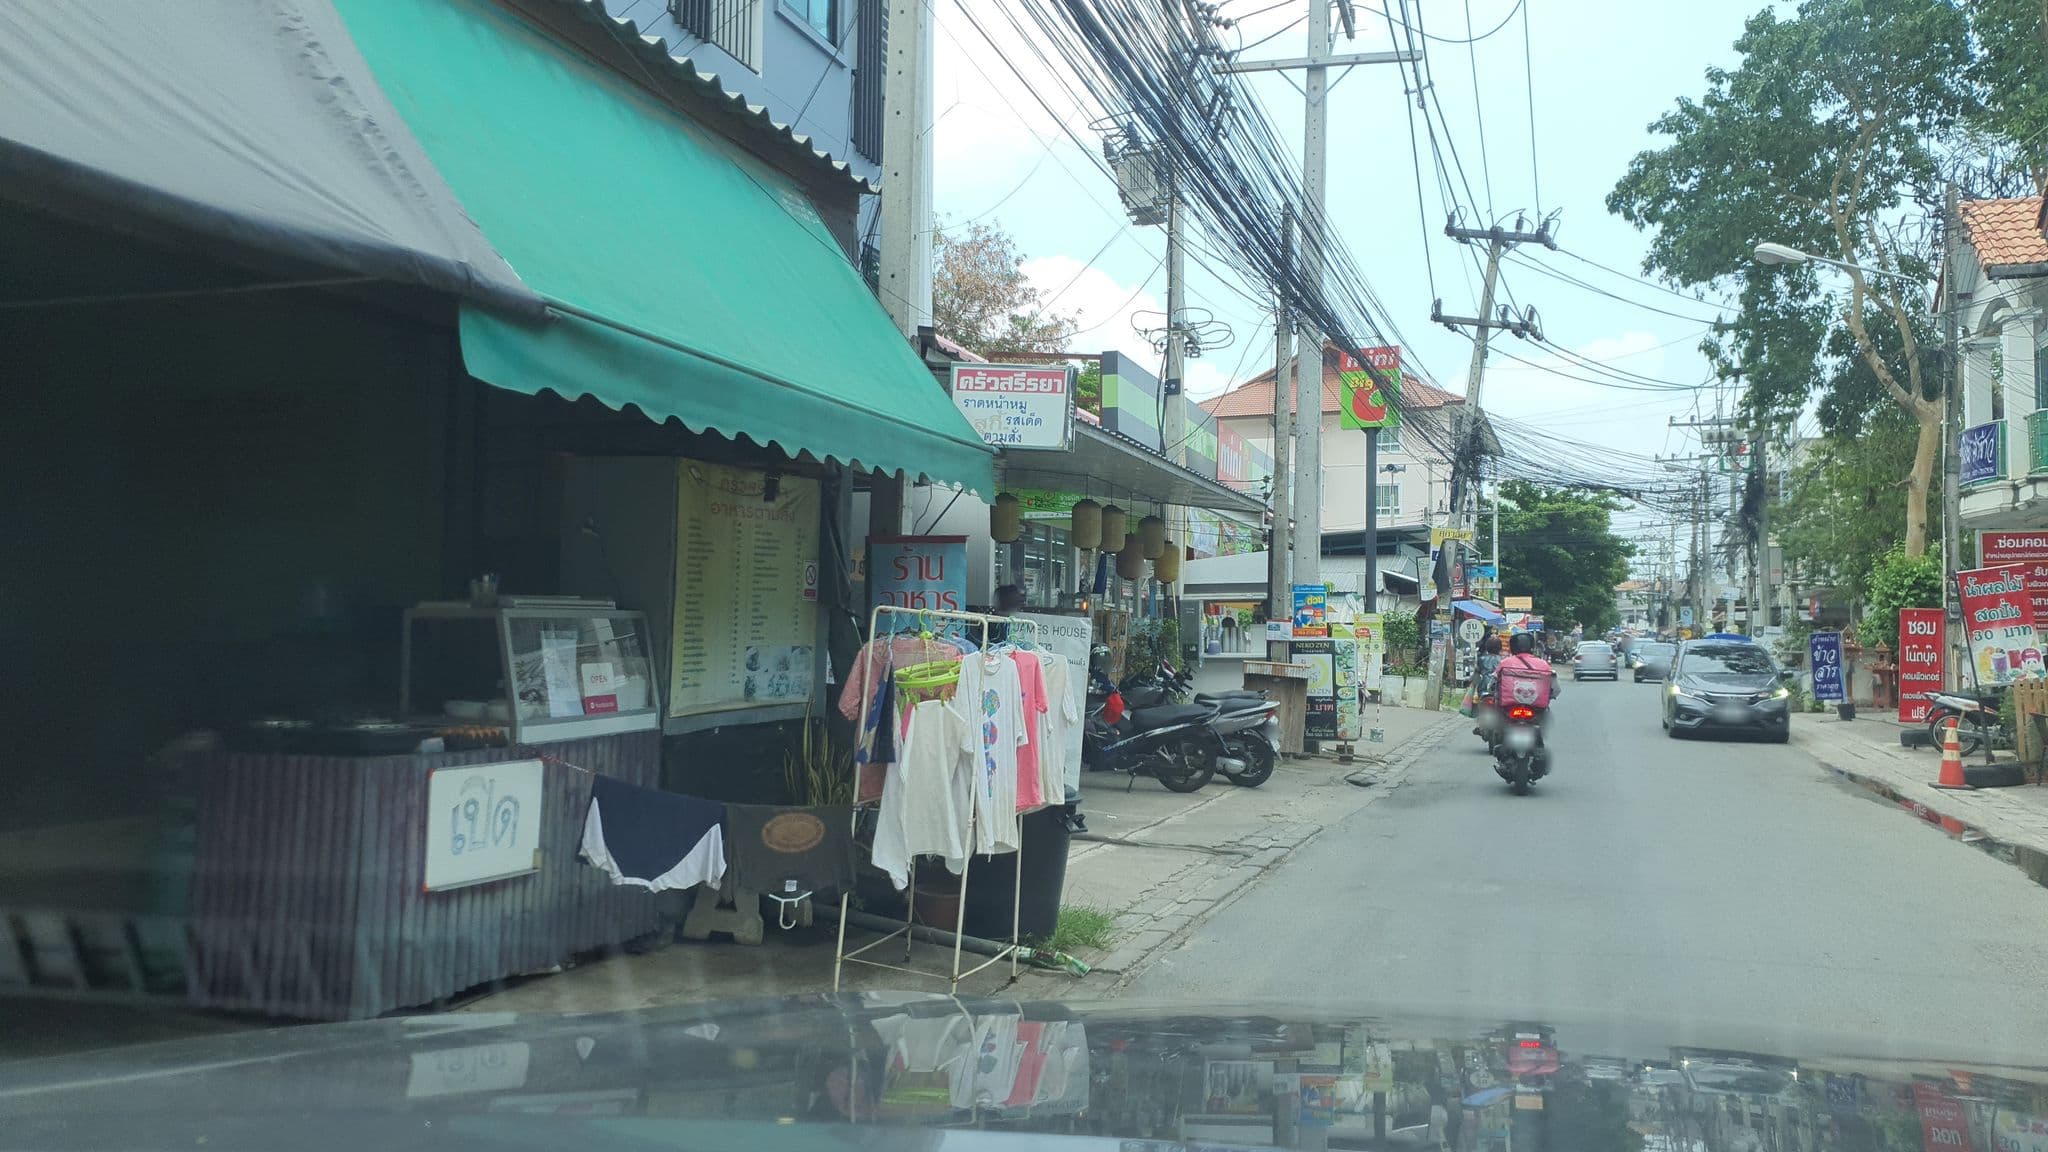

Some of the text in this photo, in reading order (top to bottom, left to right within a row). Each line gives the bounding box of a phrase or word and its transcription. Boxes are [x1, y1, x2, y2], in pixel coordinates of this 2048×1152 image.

[1350, 375, 1374, 391] Big
[963, 395, 1028, 414] ราดหน้าหมู
[1006, 412, 1042, 427] รสเด็ด
[892, 545, 944, 581] ร้าน
[1965, 571, 2024, 598] น้ำผลไม้
[1975, 599, 2021, 622] สดปั่น
[1052, 626, 1087, 639] HOUSE
[1973, 629, 1994, 642] 30
[2004, 624, 2033, 639] บาท
[1813, 645, 1836, 664] ข้าว
[591, 674, 608, 684] OPEN
[1815, 664, 1838, 683] สาร
[1911, 705, 1926, 719] ฟรี
[449, 775, 520, 856] เปิด
